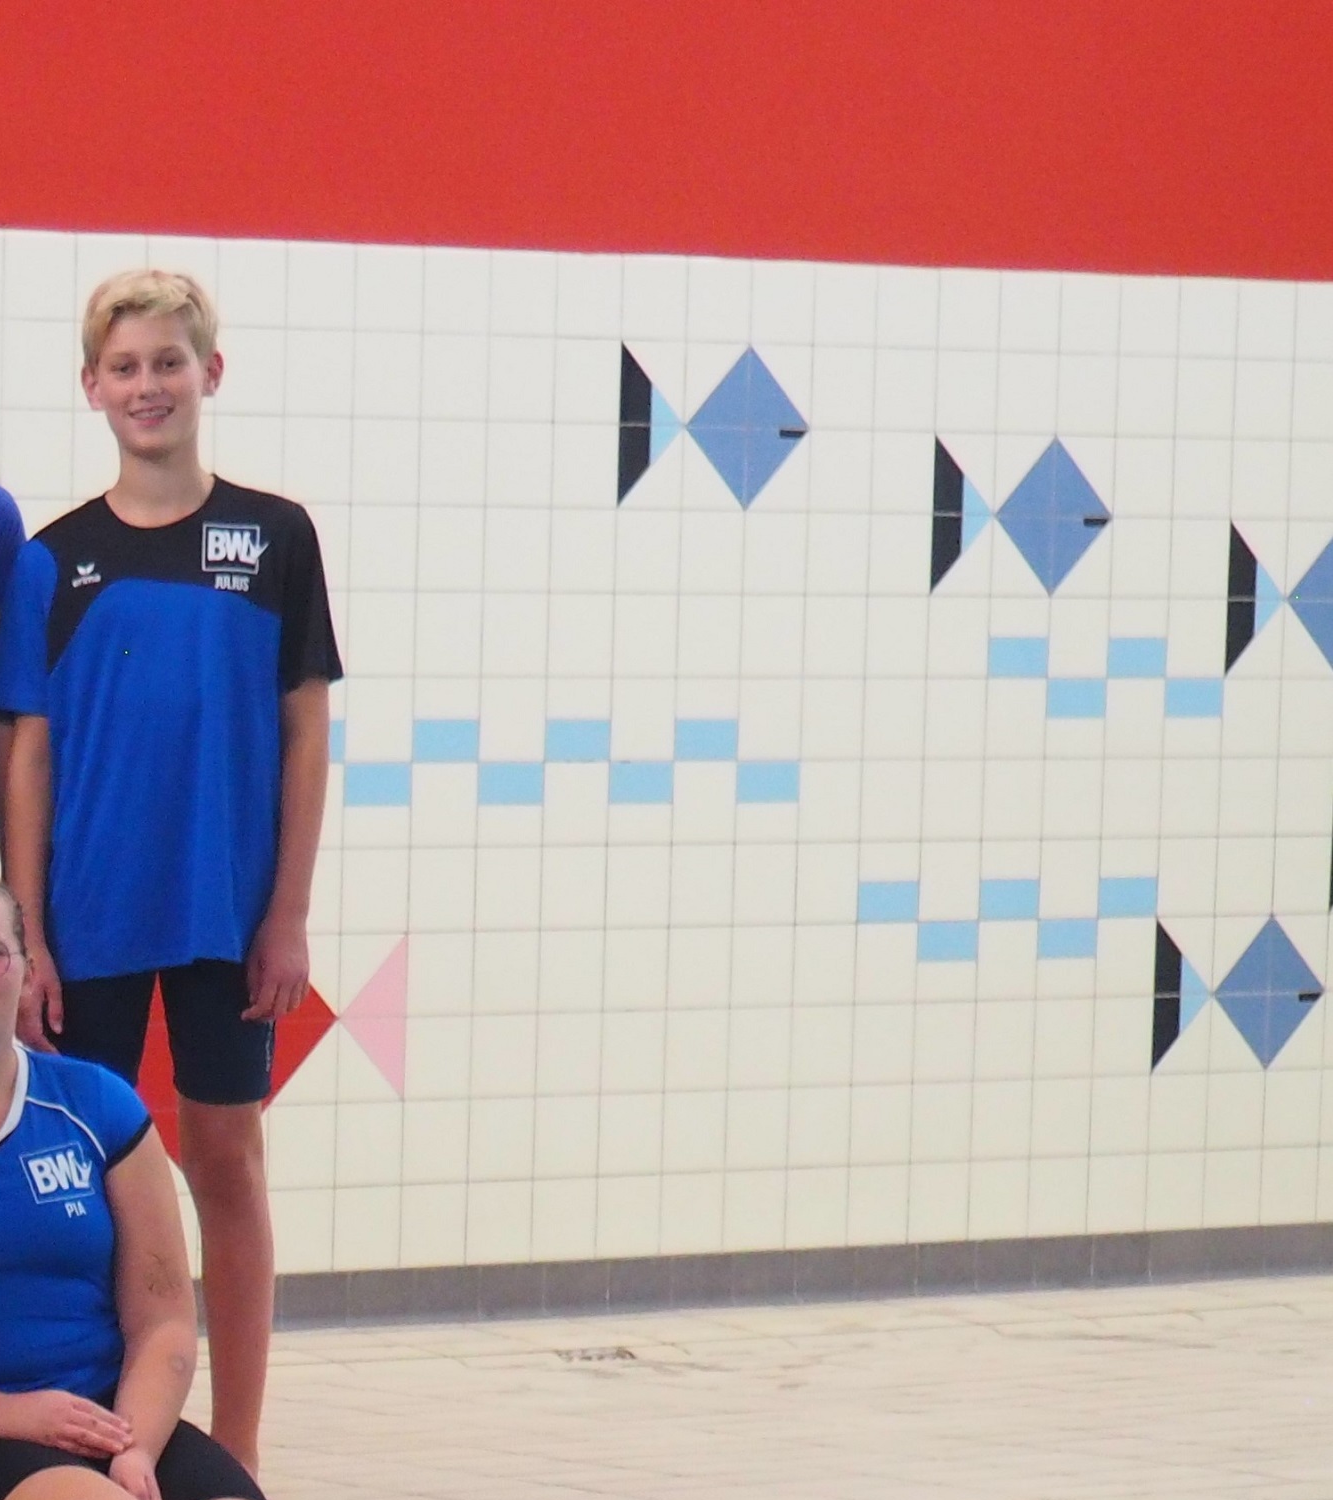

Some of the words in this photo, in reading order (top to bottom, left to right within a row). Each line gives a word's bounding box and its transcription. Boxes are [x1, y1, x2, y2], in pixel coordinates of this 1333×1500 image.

[208, 530, 260, 565] BWL
[215, 574, 250, 592] JULIUS
[27, 1150, 91, 1194] BWL
[64, 1201, 87, 1218] PIA
